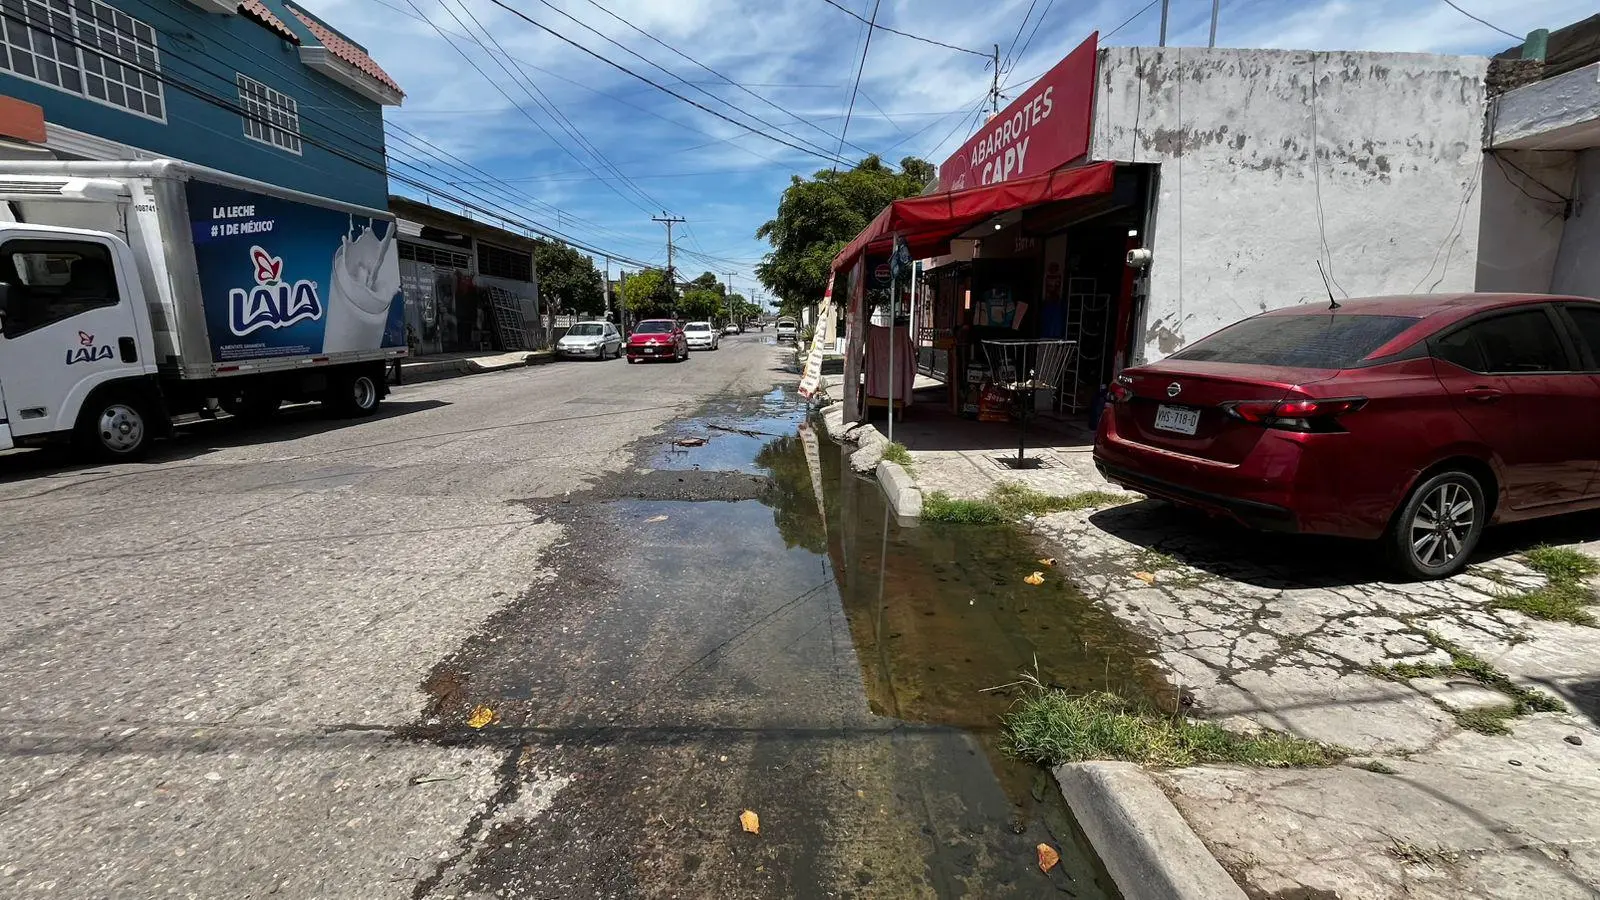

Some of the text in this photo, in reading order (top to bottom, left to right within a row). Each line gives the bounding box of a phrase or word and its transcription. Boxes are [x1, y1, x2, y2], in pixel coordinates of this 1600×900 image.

[970, 86, 1053, 168] ABARROTES
[982, 137, 1029, 185] CAPY
[213, 205, 255, 219] LA LECHE
[211, 225, 218, 236] #
[220, 224, 225, 236] 1
[226, 223, 239, 235] DE
[231, 281, 321, 333] LALA
[66, 345, 114, 365] LALA
